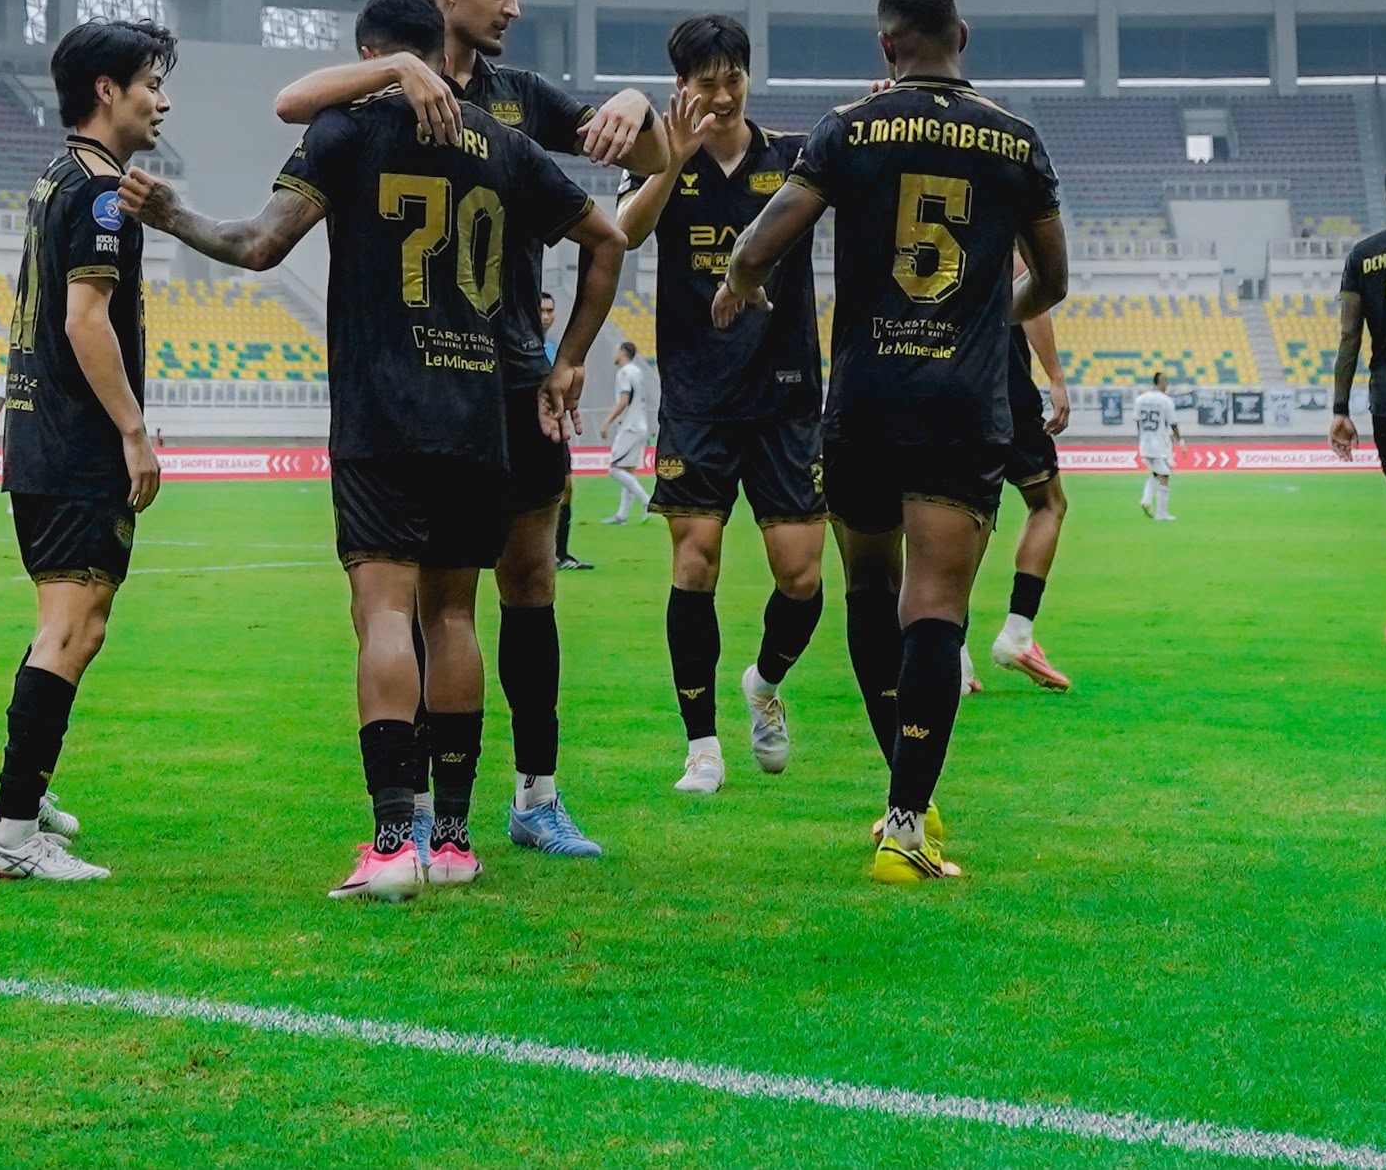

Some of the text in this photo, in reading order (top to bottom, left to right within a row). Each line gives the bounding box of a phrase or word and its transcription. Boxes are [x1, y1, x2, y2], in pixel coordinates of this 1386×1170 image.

[848, 116, 1031, 164] J.MANGABEIRA
[379, 173, 506, 322] 70
[892, 173, 973, 305] 5
[425, 352, 442, 367] Le
[878, 341, 893, 355] Le
[1140, 410, 1161, 431] 25
